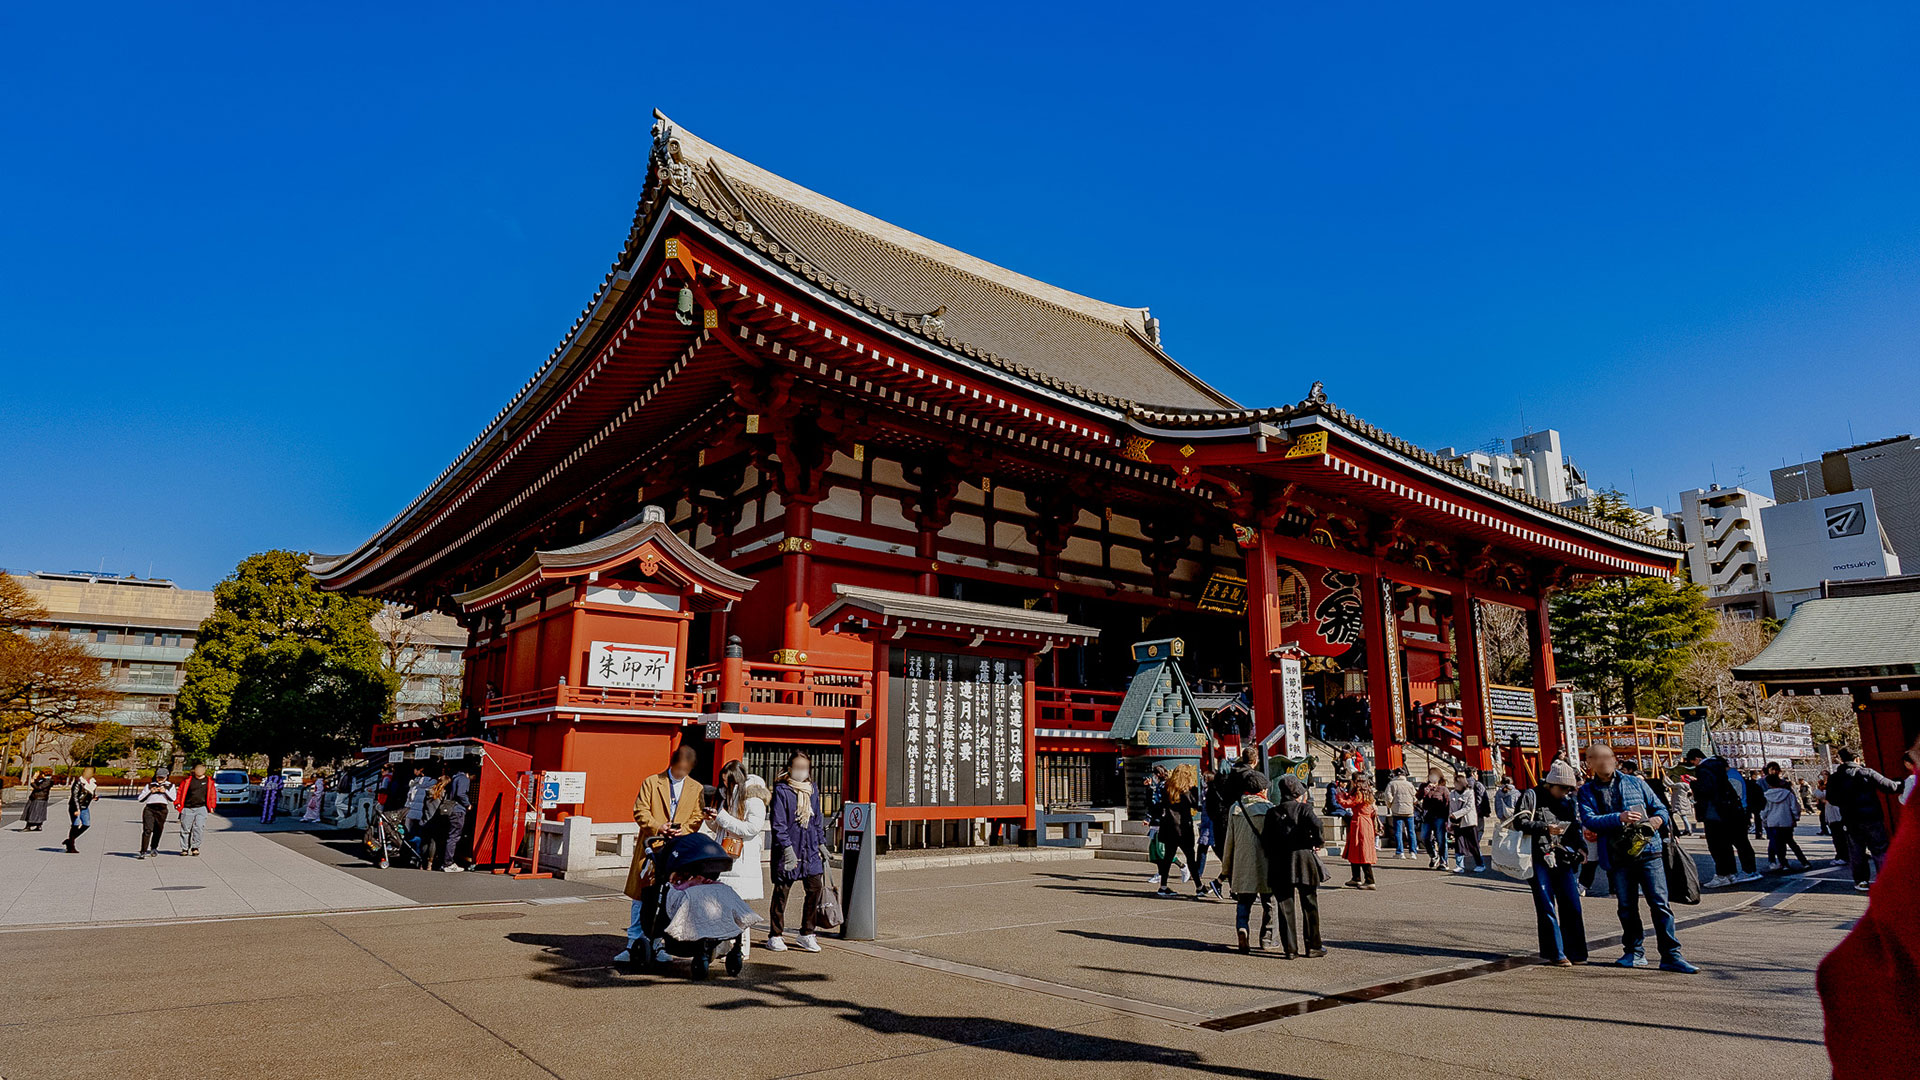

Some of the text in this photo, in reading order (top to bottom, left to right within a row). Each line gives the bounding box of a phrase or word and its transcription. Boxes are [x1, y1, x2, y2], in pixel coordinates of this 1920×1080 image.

[1833, 560, 1877, 571] matsukiyo
[599, 653, 666, 683] 朱印所
